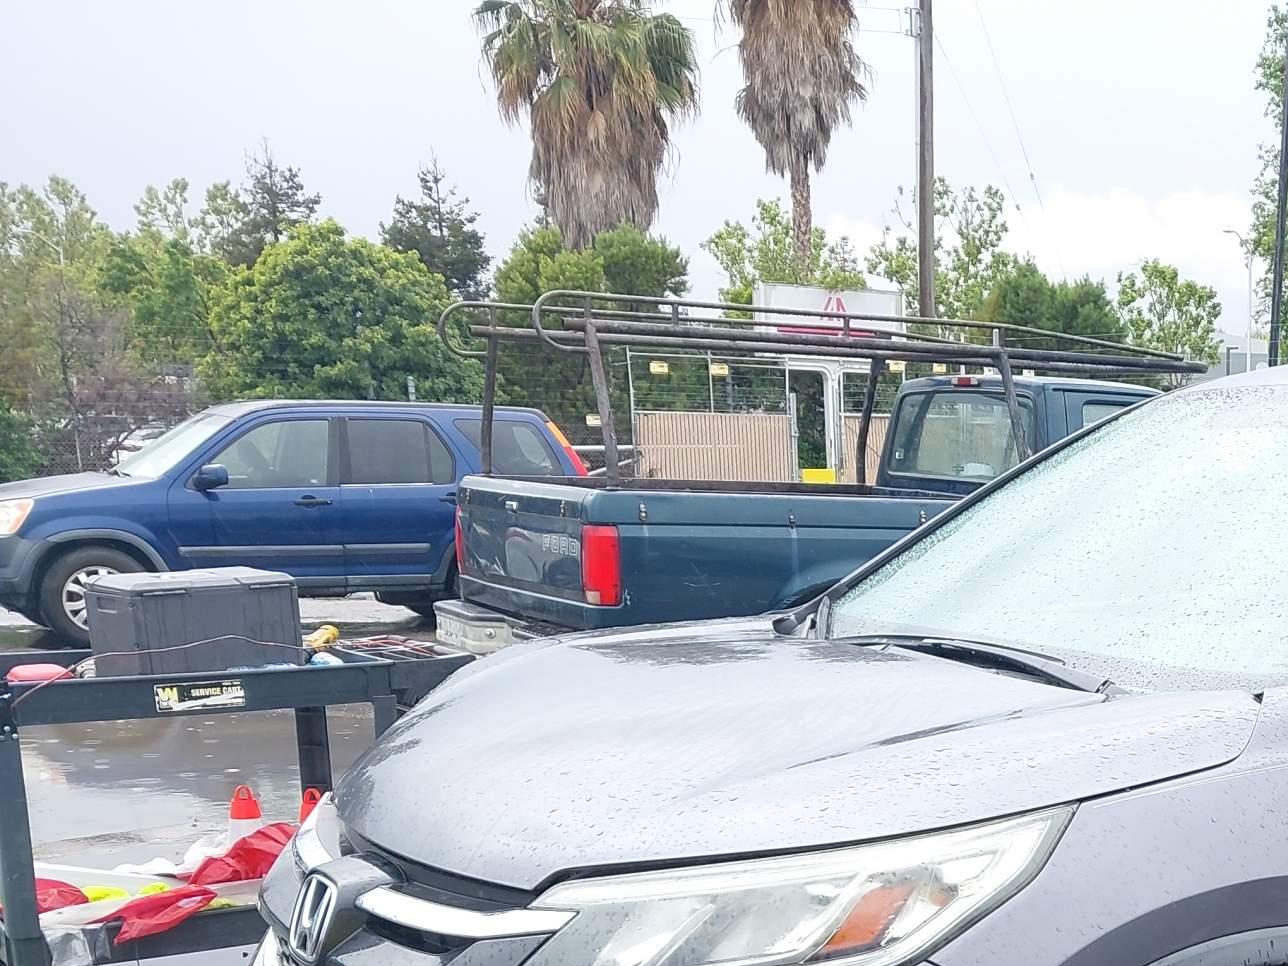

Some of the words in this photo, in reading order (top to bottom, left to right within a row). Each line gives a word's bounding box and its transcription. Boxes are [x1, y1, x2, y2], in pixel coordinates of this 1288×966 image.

[542, 534, 578, 556] FORD
[190, 687, 222, 697] SERVICE
[222, 685, 241, 696] CART
